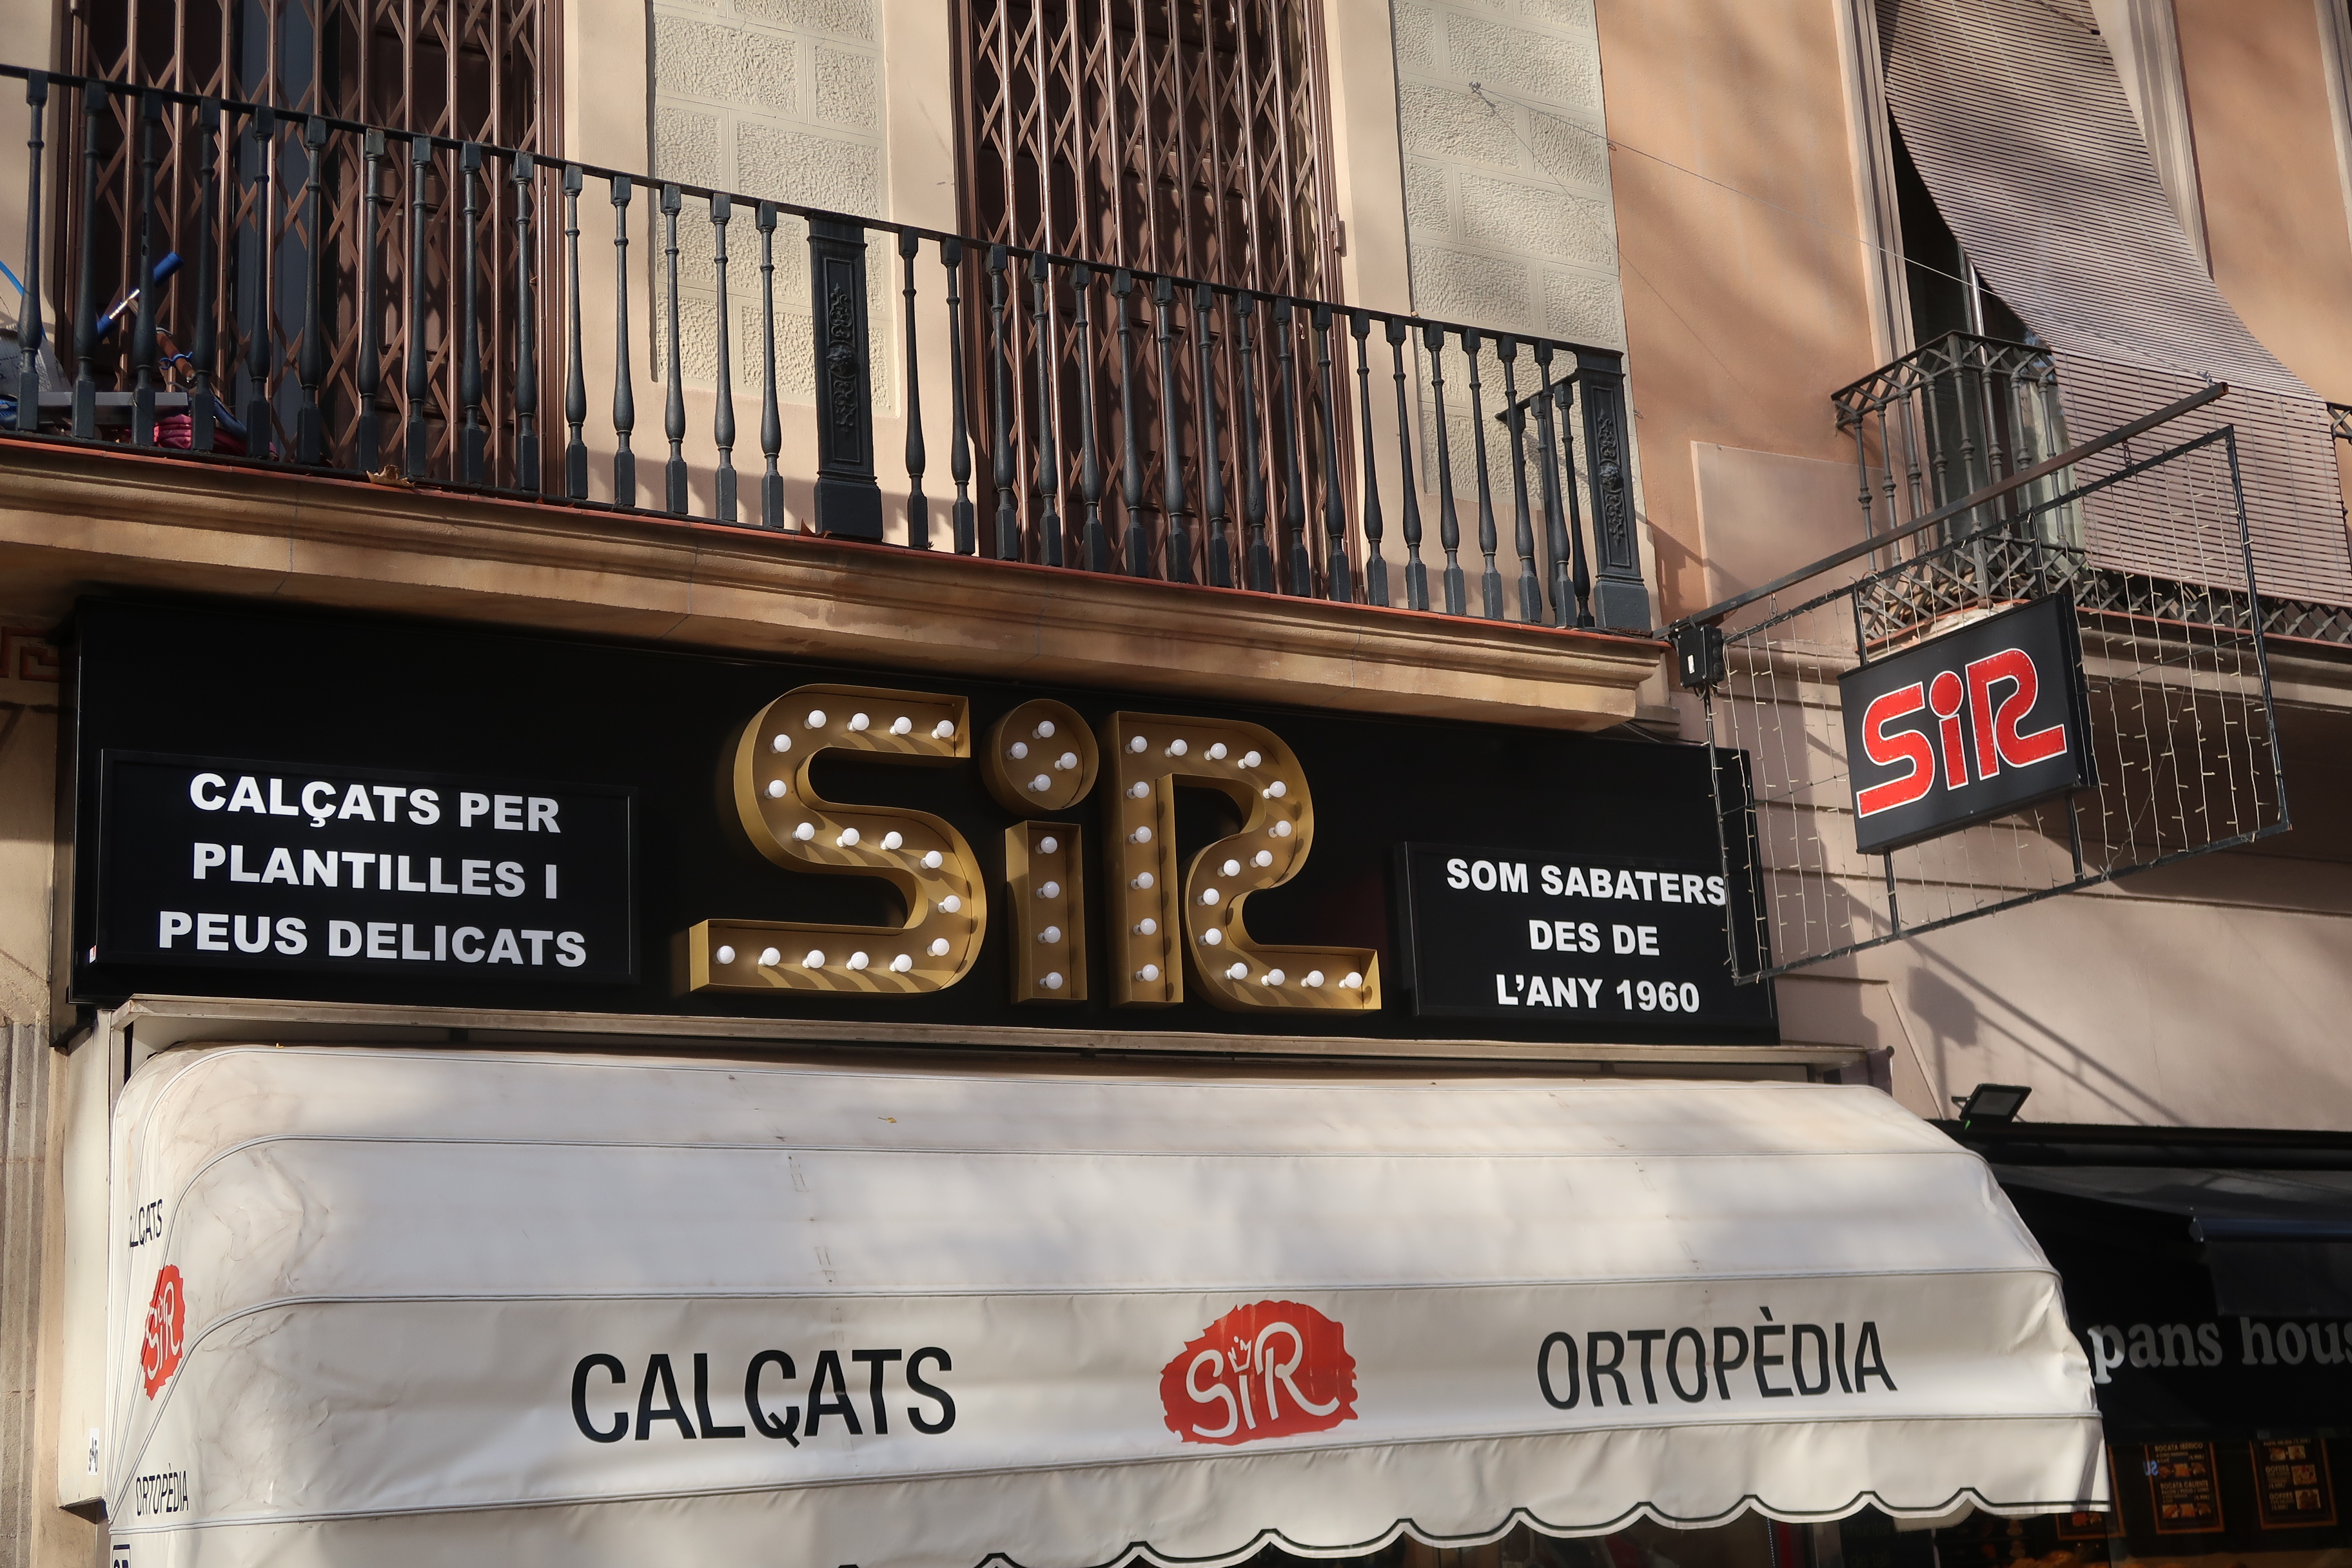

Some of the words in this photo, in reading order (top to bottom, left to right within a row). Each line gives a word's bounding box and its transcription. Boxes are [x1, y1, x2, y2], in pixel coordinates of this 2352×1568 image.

[189, 772, 440, 828] CALÇATS
[460, 792, 561, 833] PER
[193, 842, 525, 897] PLANTILLES
[545, 864, 557, 899] I
[1447, 858, 1529, 894] SOM
[1541, 865, 1727, 906] SABATERS
[159, 910, 308, 954] PEUS
[328, 919, 587, 968] DELICATS
[1529, 919, 1601, 953] DES
[1612, 924, 1660, 956] DE
[1616, 979, 1700, 1013] 1960
[1537, 1306, 1897, 1410] ORTOPÈDIA
[2087, 1323, 2223, 1384] pans
[135, 1462, 189, 1516] ORTOPÈDIA
